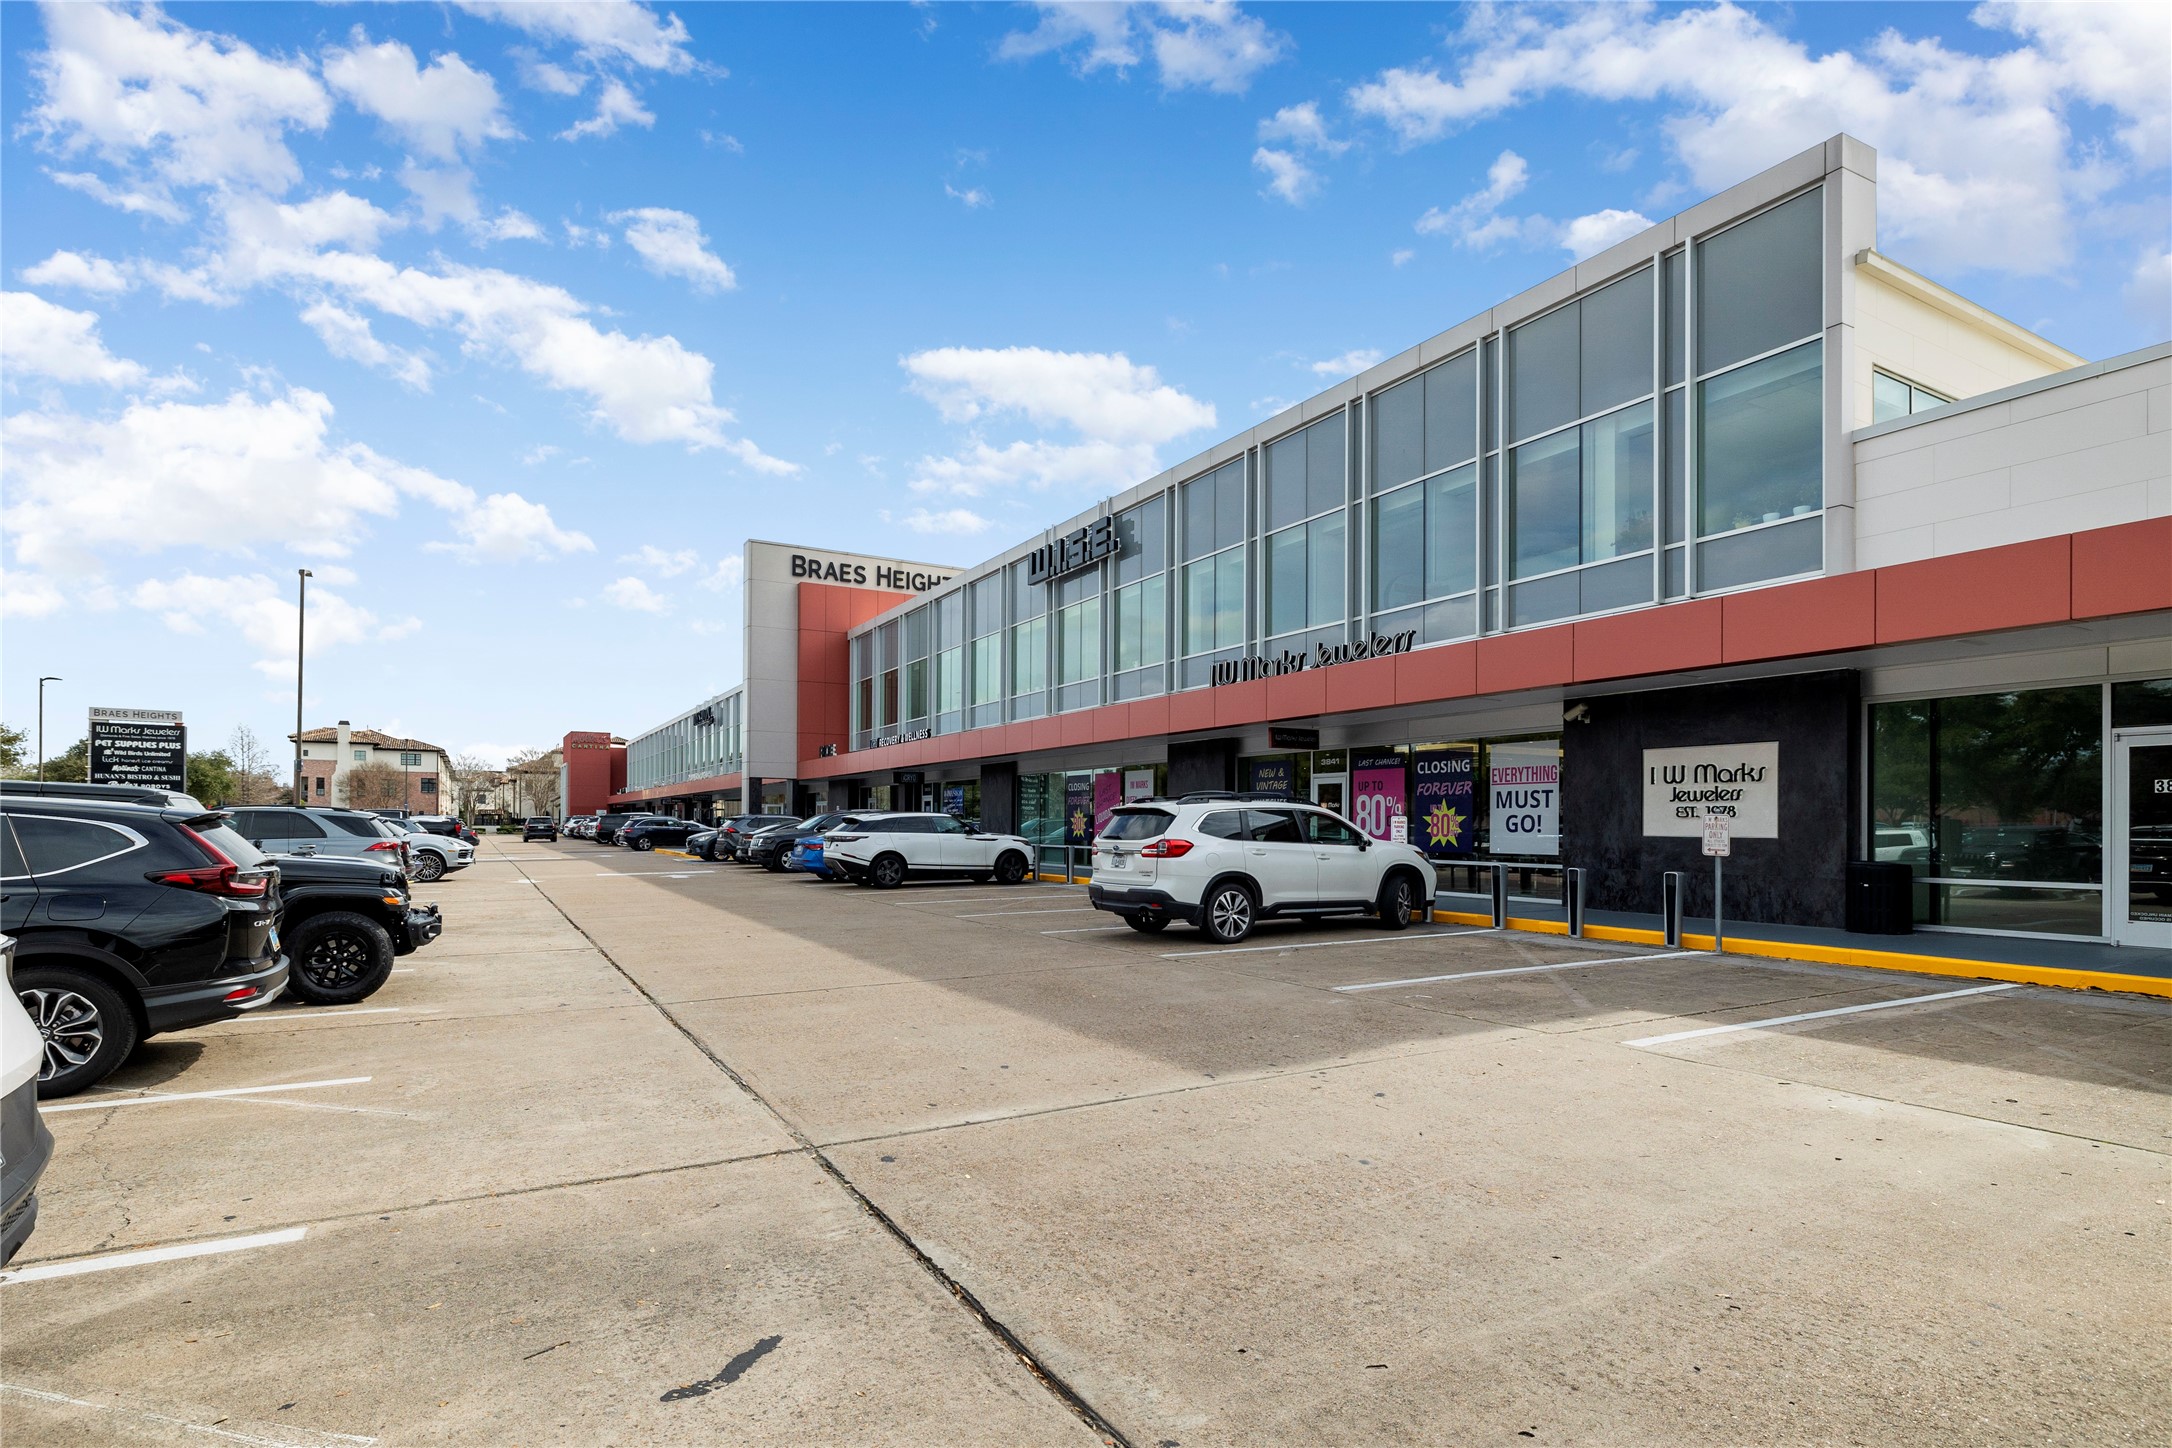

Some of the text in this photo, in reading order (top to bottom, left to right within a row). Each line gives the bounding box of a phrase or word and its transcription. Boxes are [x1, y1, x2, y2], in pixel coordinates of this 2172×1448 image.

[792, 554, 953, 591] BRAES HEIGH
[1209, 629, 1417, 688] IW Marks Jewelers
[93, 708, 178, 720] BRAES HEIGHTS
[96, 725, 181, 736] IW Marks Jewelers
[94, 739, 181, 749] PET SUPPLIES PLUS
[878, 735, 900, 747] RECOVERY
[904, 728, 929, 742] WELLNESS
[1320, 758, 1340, 766] 3841
[1358, 758, 1401, 767] LAST CHANCE!
[1417, 760, 1470, 774] CLOSING
[1258, 767, 1285, 778] NEW &
[1491, 765, 1558, 783] EVERYTHING
[1663, 765, 1686, 784] W
[1693, 763, 1767, 783] Marks
[1068, 783, 1090, 791] CLOSING
[1256, 780, 1288, 790] VINTAGE
[1358, 781, 1384, 792] UP TO
[1417, 780, 1473, 796] FOREVER
[1496, 790, 1554, 809] MUST
[1669, 786, 1744, 802] Jewelers
[1676, 806, 1700, 818] EST.
[1505, 814, 1542, 833] GO!
